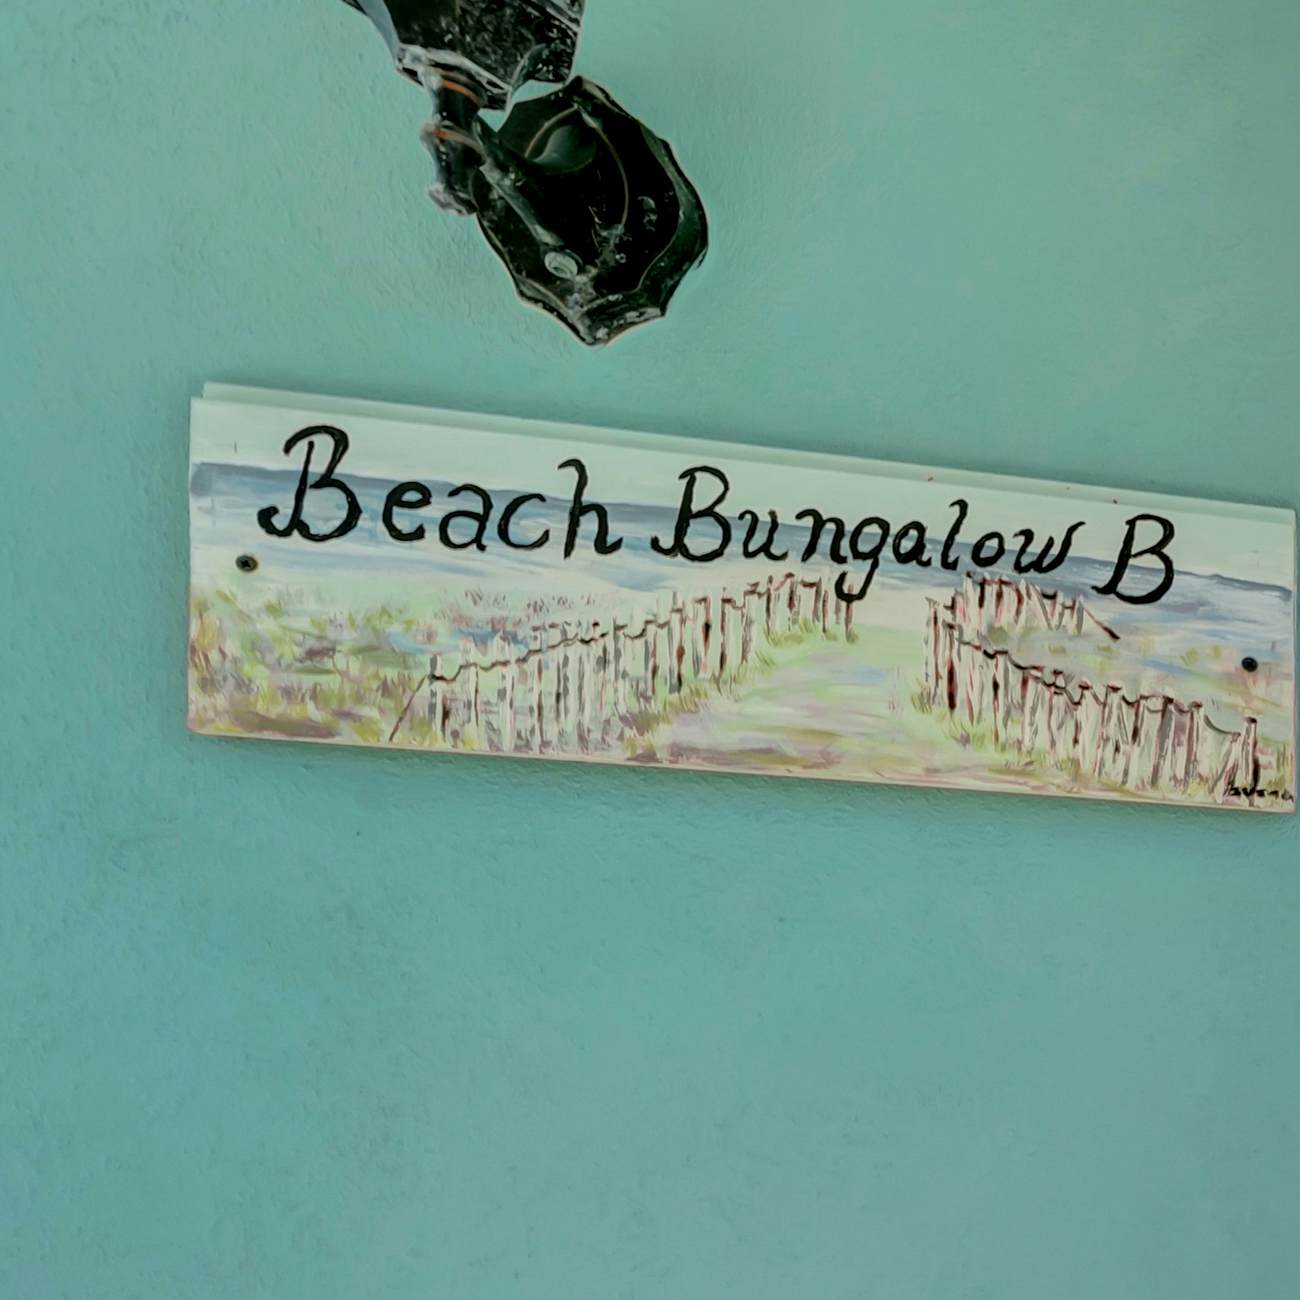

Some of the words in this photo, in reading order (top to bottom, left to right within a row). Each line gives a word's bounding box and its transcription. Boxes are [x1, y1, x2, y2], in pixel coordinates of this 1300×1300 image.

[257, 425, 623, 559] Beach
[650, 466, 1086, 603] Bungalow
[1090, 513, 1176, 604] B
